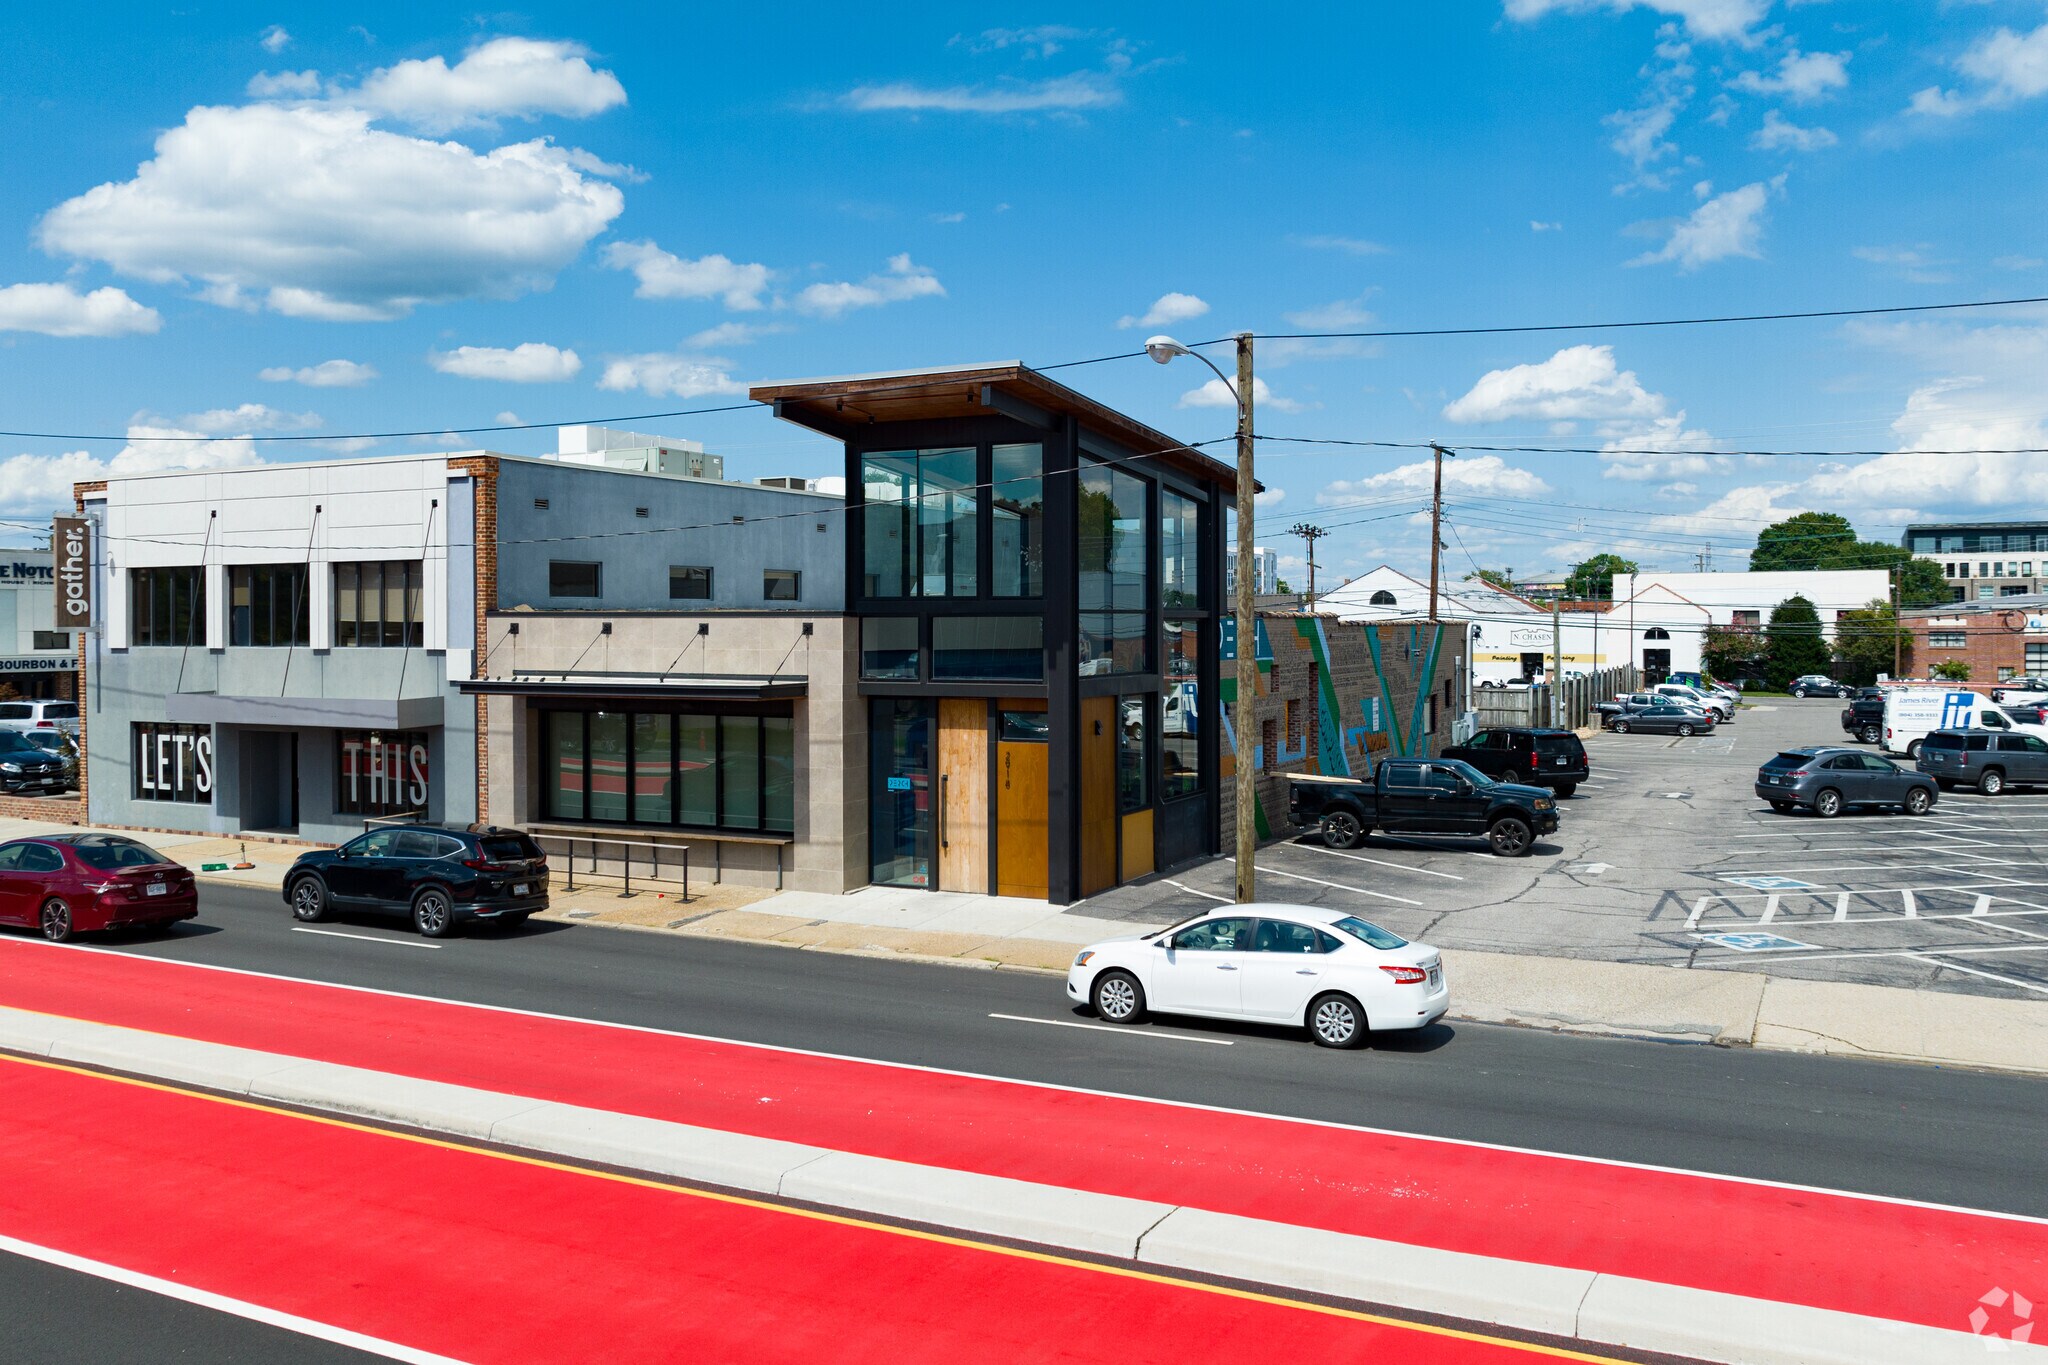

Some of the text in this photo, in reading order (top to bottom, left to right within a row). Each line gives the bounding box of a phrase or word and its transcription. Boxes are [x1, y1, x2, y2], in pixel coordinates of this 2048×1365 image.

[60, 527, 88, 615] gather.
[59, 659, 68, 668] &
[141, 733, 212, 793] LET'S
[344, 742, 427, 806] THIS
